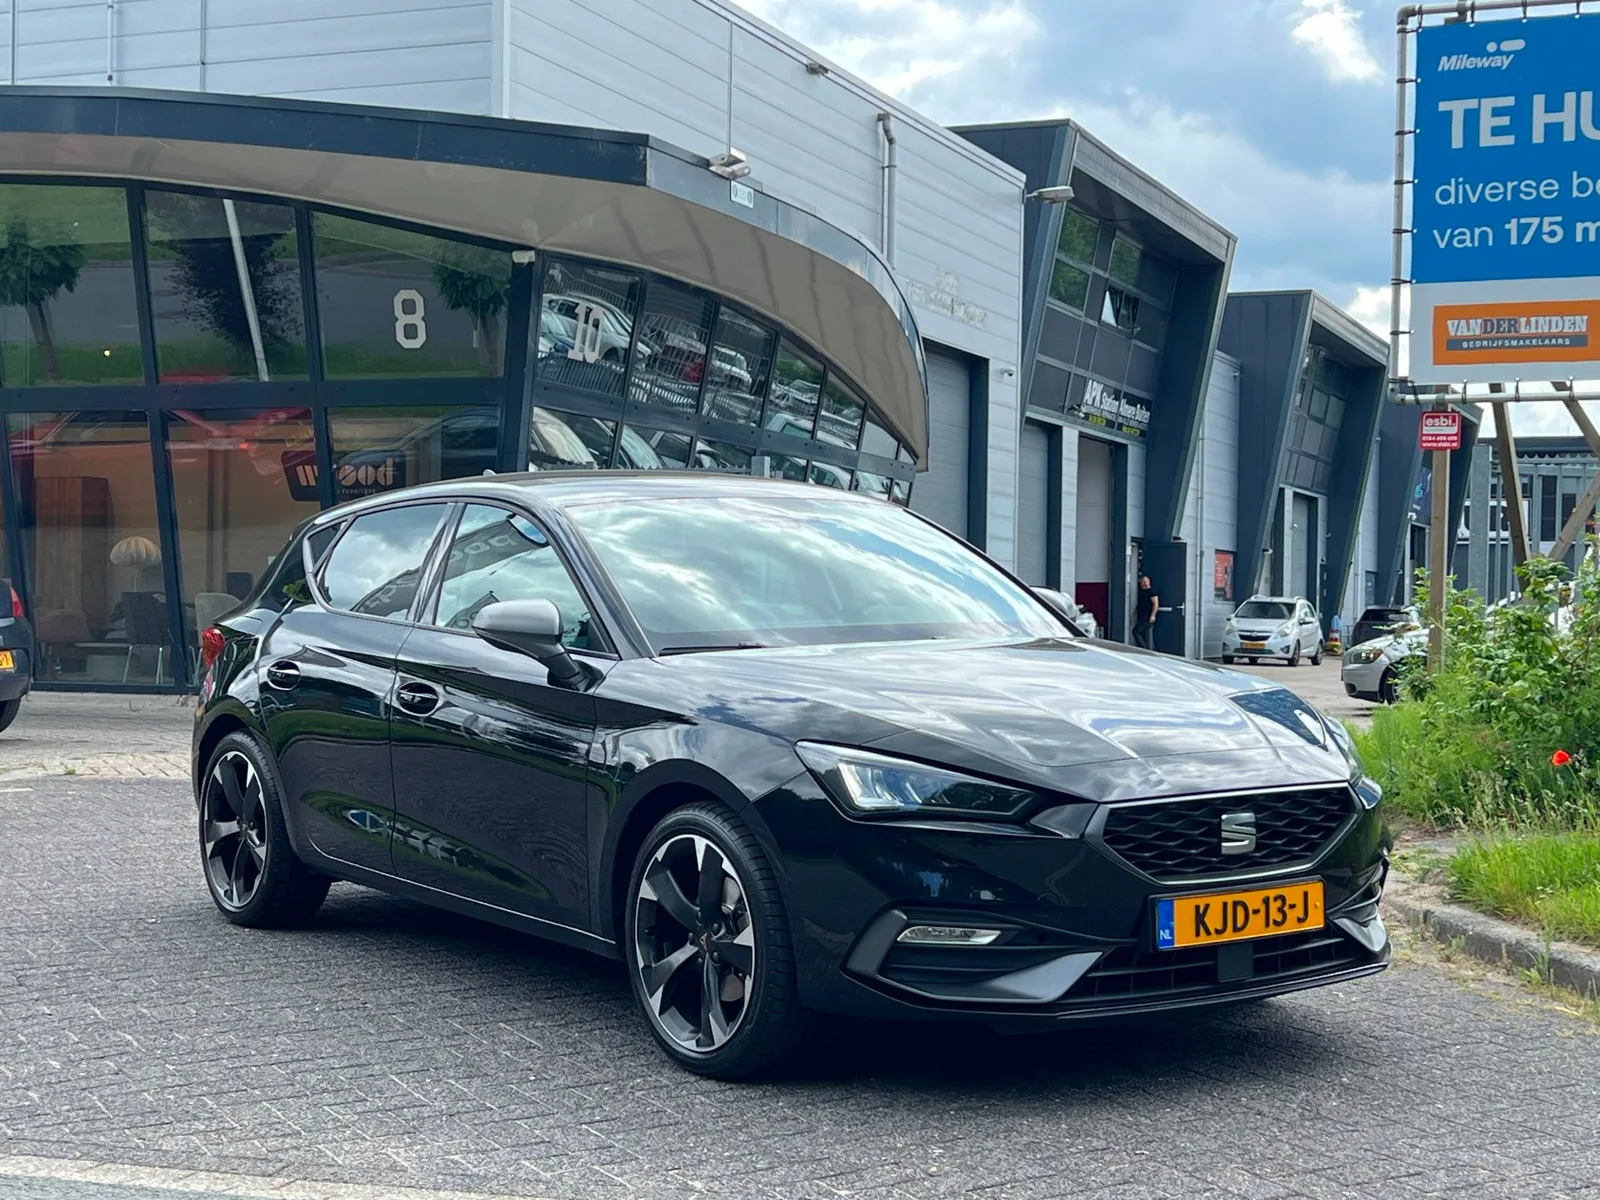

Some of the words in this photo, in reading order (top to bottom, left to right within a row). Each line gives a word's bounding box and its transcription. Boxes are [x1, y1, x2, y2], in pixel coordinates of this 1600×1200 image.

[1437, 54, 1514, 72] Mileway
[1438, 95, 1515, 149] TE
[1434, 177, 1560, 205] diverse
[1572, 170, 1600, 198] b
[1432, 226, 1494, 249] van
[1504, 216, 1564, 245] 175
[392, 289, 427, 349] 8
[567, 301, 604, 364] 10
[1447, 315, 1588, 336] VANDERLINDEN
[1462, 337, 1571, 349] BEDRIJFSMAKELAARS
[1083, 379, 1104, 408] APK
[1159, 929, 1173, 941] NL
[1194, 890, 1309, 938] KJD-13-J
